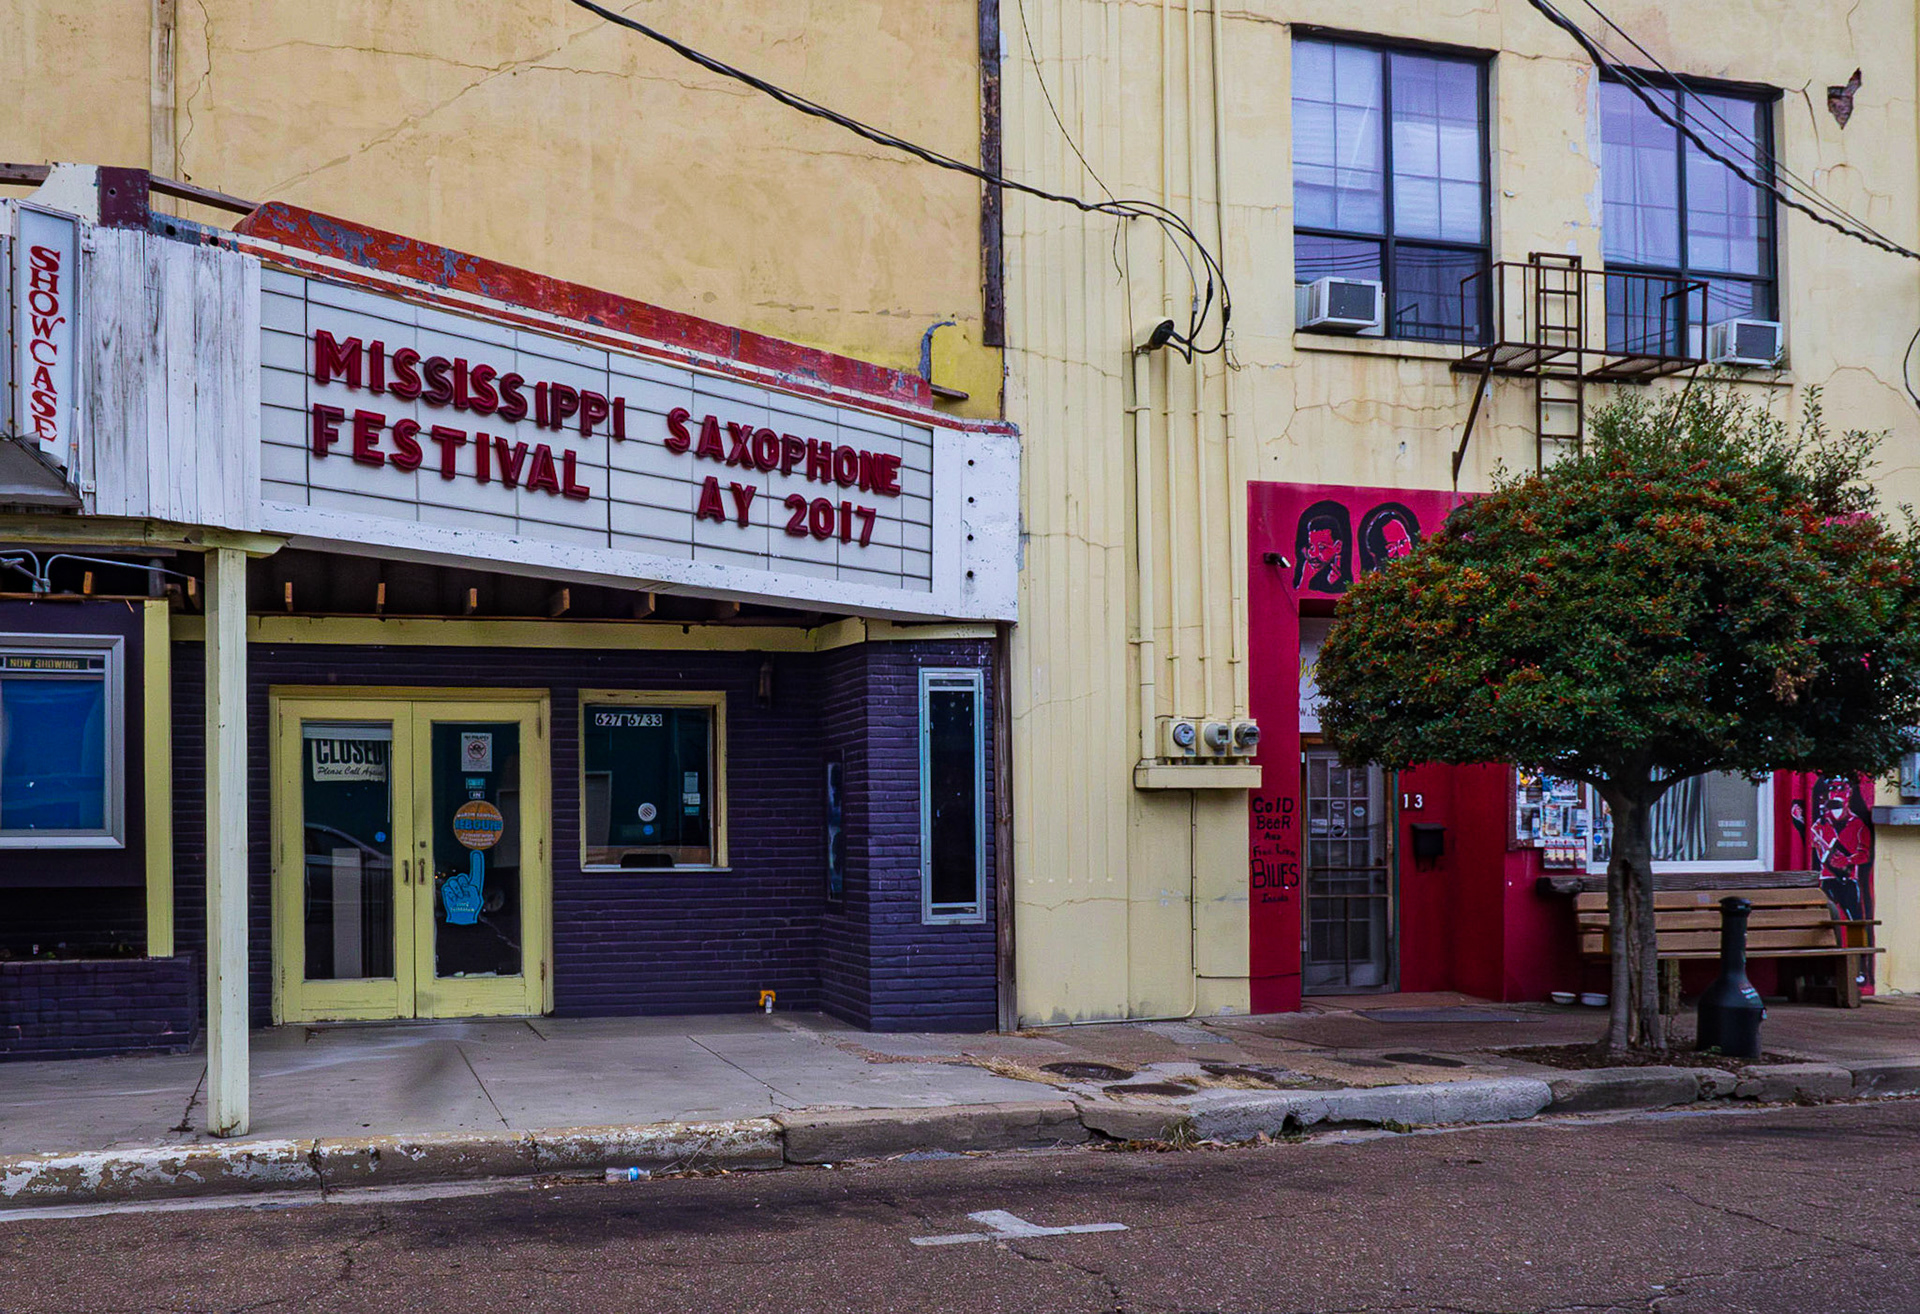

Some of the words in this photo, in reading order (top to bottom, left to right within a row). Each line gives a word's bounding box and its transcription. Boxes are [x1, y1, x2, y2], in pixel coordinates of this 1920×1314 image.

[28, 245, 66, 443] SHOWCASE
[315, 328, 626, 442] MISSISSIPPI
[664, 407, 902, 498] SAXOPHONE
[312, 402, 591, 501] FESTIVAL
[695, 475, 758, 528] AY
[783, 493, 877, 548] 2017
[9, 658, 32, 669] NOW
[34, 658, 79, 670] SHOWING
[596, 713, 622, 727] 627
[627, 713, 663, 727] 6733
[315, 739, 384, 766] CLOSED
[344, 765, 361, 776] Call
